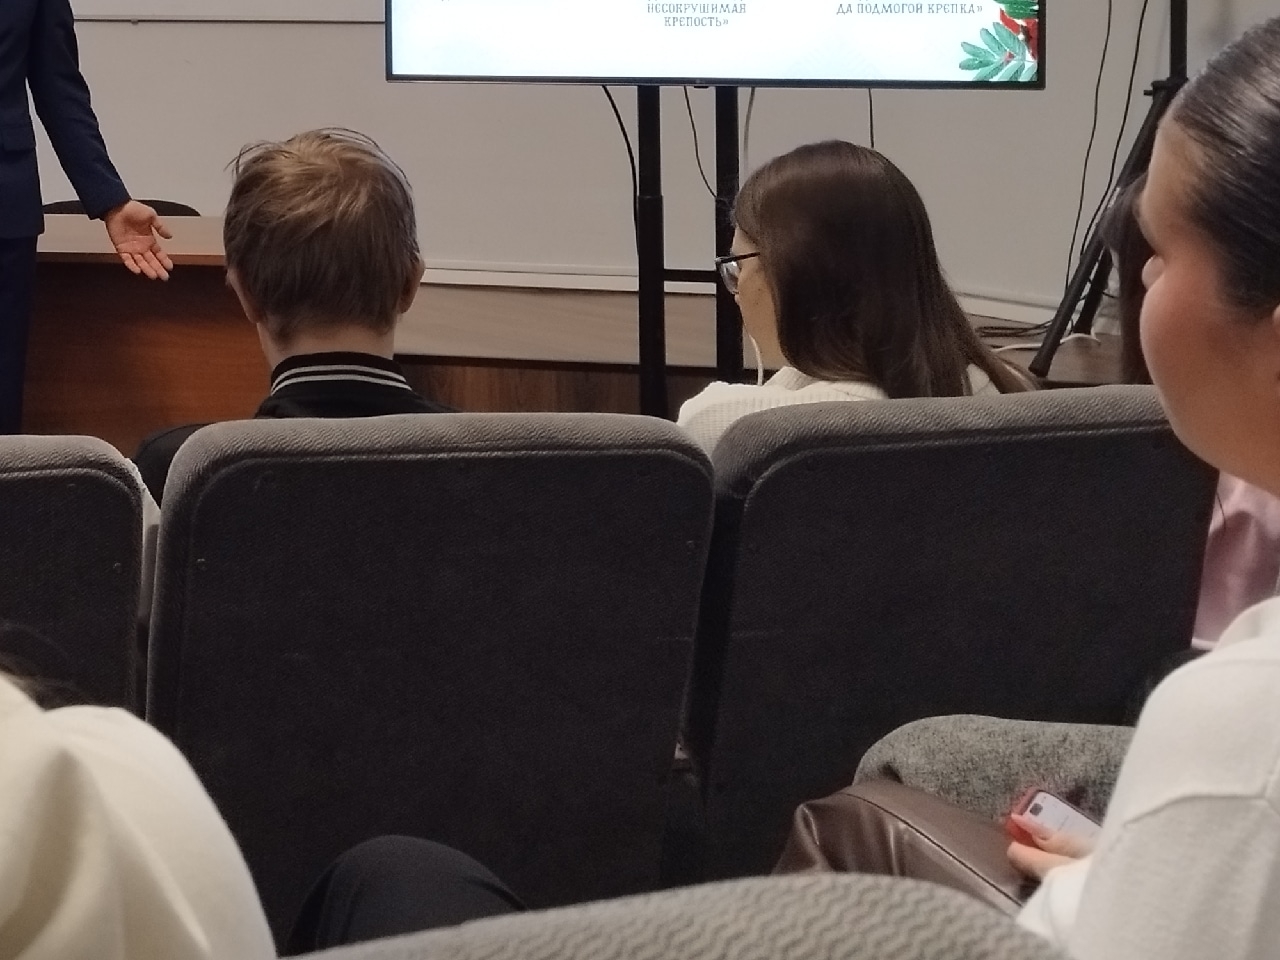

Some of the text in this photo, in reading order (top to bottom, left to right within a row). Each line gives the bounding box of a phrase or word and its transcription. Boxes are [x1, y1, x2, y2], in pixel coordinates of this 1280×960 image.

[647, 3, 746, 14] НЕСОКРУШИМАЯ
[836, 3, 853, 15] ДА
[857, 3, 923, 15] ПОДМОГОЙ
